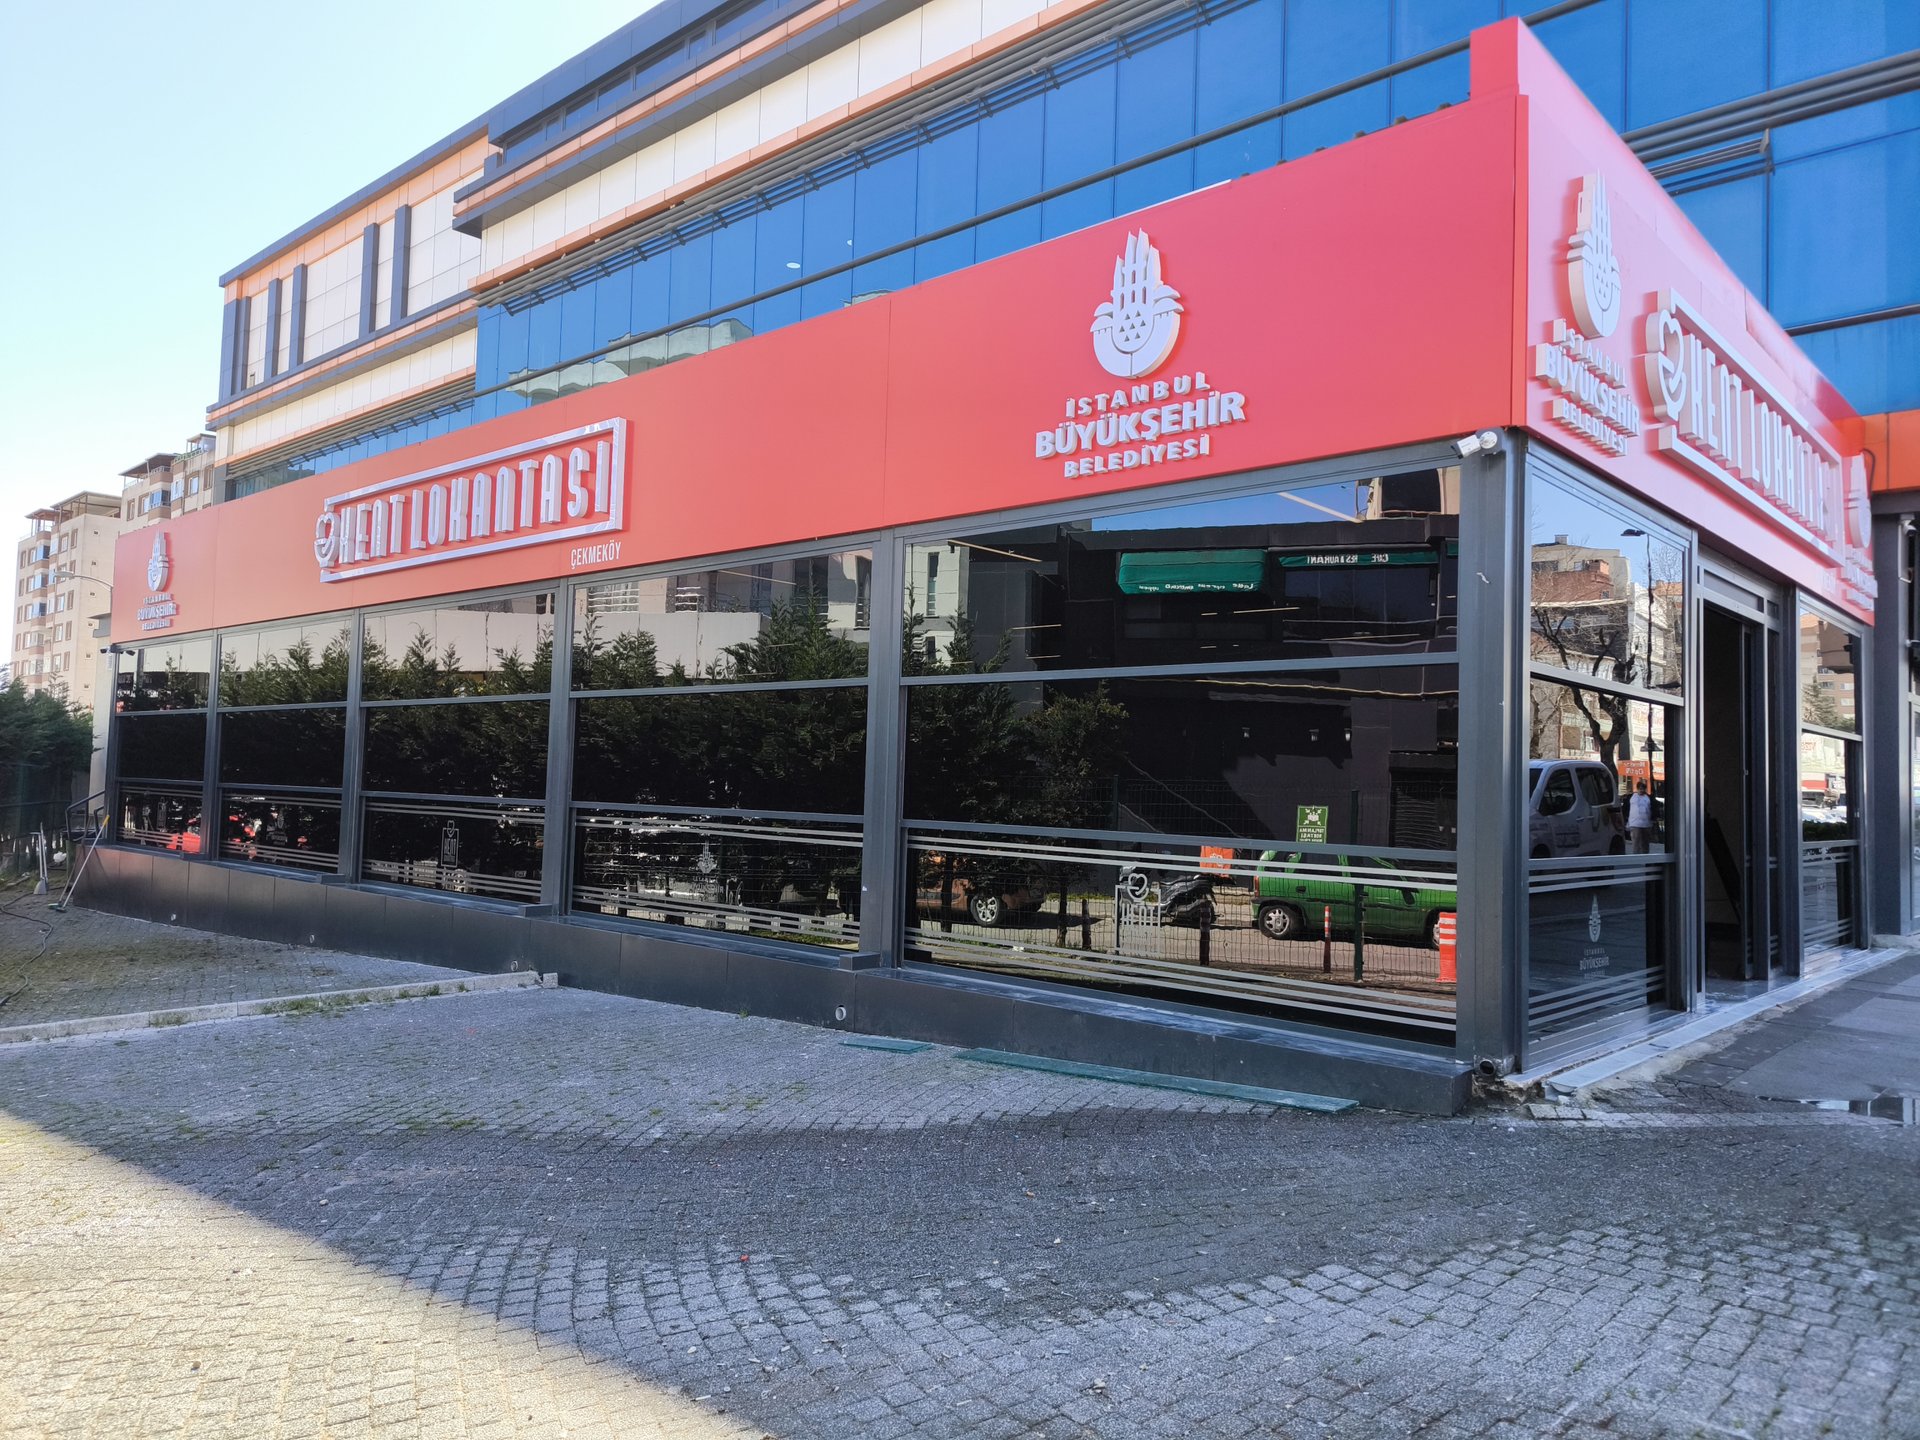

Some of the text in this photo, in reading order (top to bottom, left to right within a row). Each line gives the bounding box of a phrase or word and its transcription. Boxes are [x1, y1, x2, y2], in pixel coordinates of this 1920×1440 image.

[1065, 371, 1211, 418] İSTANBUL
[1680, 333, 1742, 469] KENT
[1035, 390, 1246, 459] BÜYÜKŞEHİR
[1064, 433, 1210, 479] BELEDİYESİ
[339, 440, 610, 564] KENT LOKANTASI
[571, 540, 622, 569] ÇEKMEKÖY
